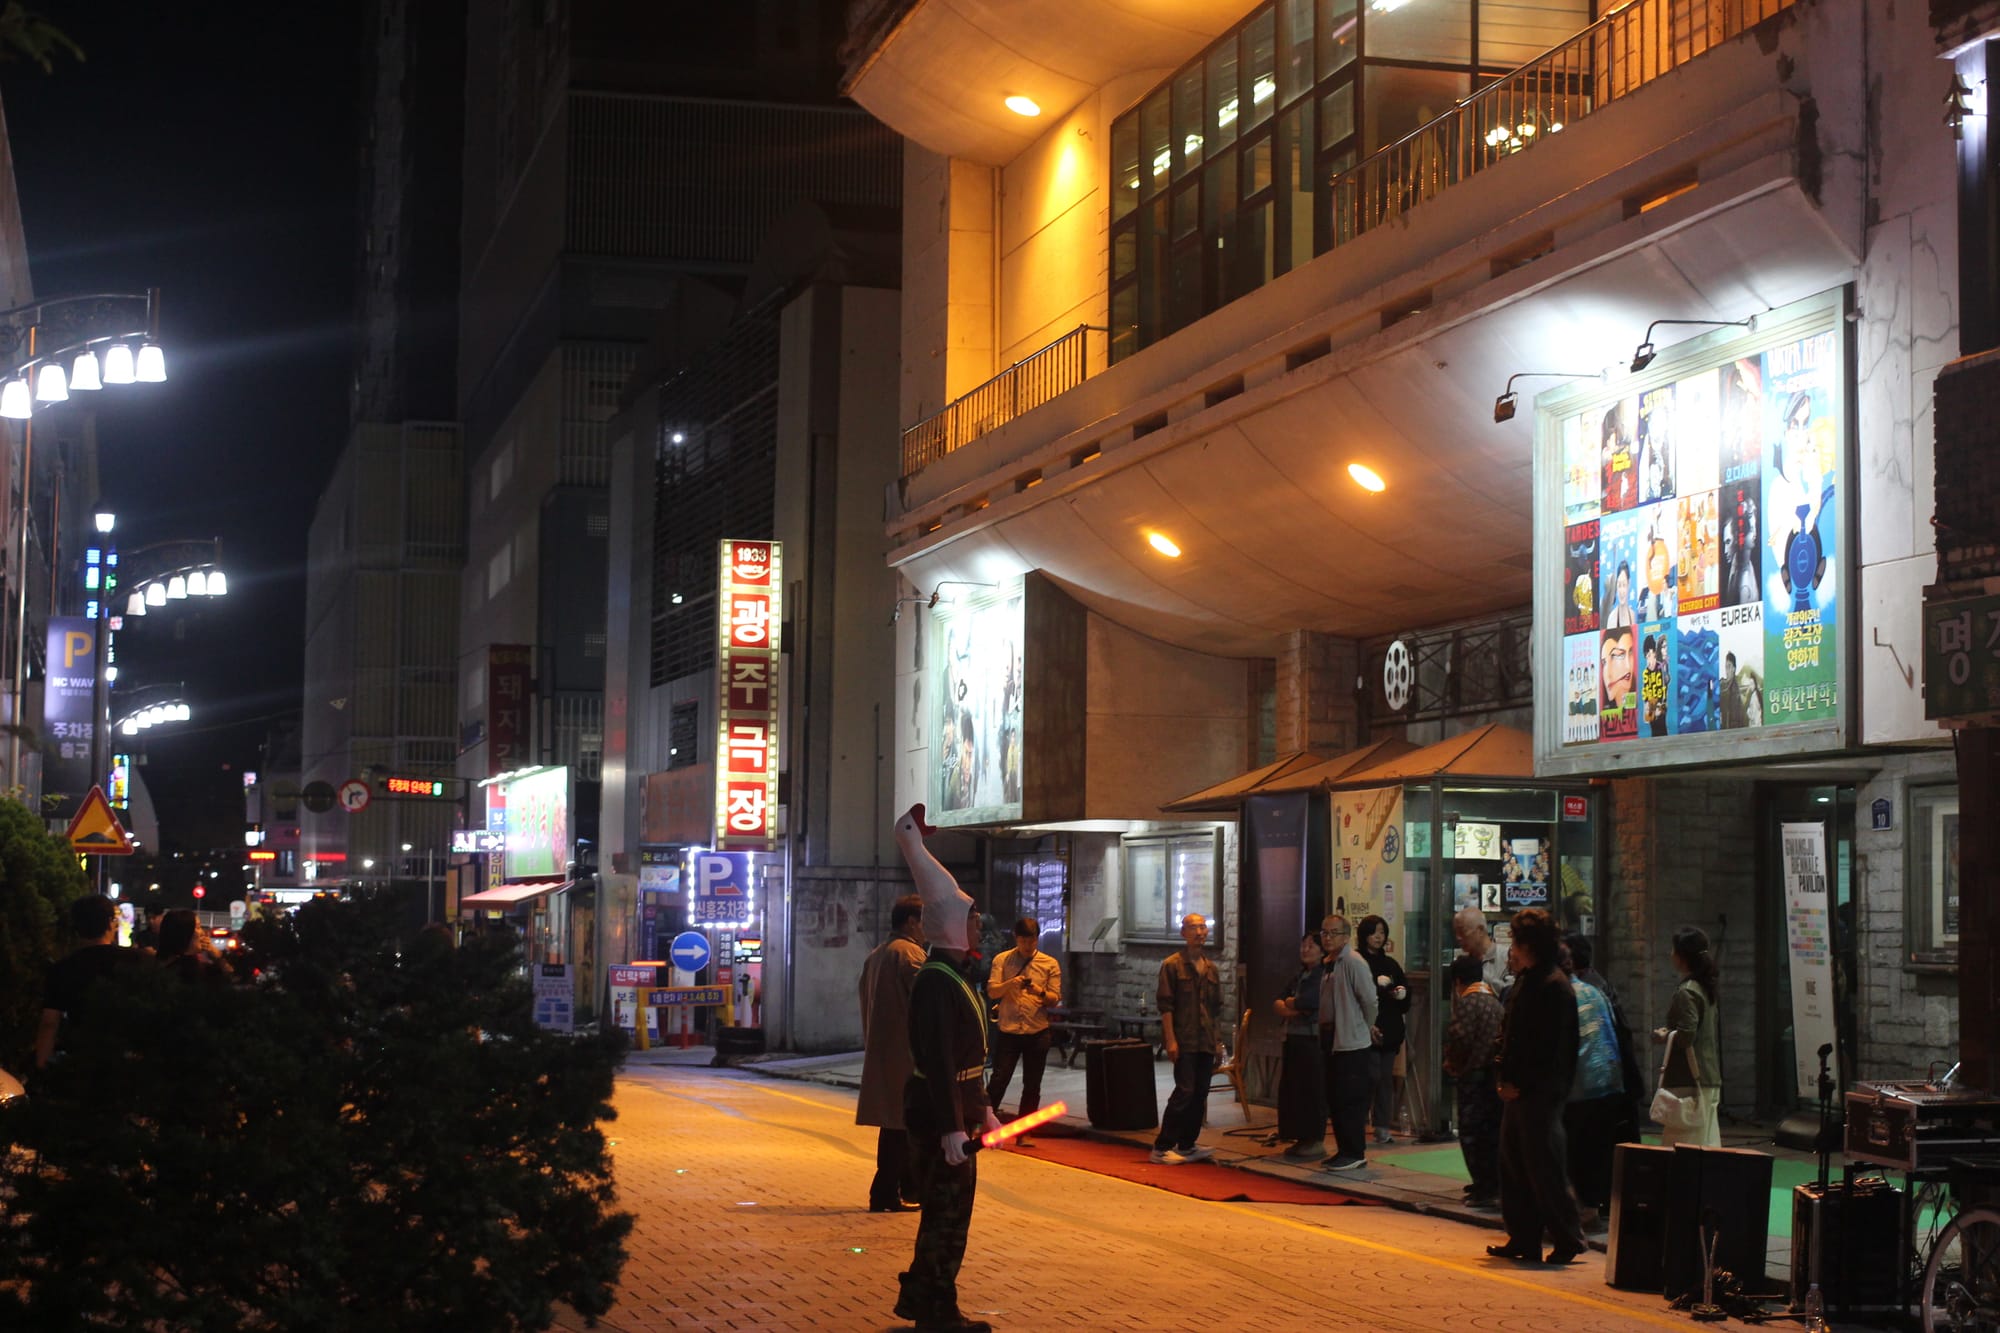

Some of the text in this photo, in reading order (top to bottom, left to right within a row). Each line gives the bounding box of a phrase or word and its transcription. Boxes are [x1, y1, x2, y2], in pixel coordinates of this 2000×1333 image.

[1721, 605, 1761, 628] EUREKA
[1783, 624, 1823, 649] 광주극장
[64, 631, 92, 668] P
[1788, 646, 1819, 671] 영화제
[728, 600, 769, 831] 광주극장
[60, 742, 90, 759] 출구
[1877, 814, 1886, 827] 10
[700, 856, 733, 896] P
[1791, 856, 1819, 875] BIENNALE
[1799, 874, 1825, 893] PAVILION
[696, 901, 747, 919] 신흥주차장
